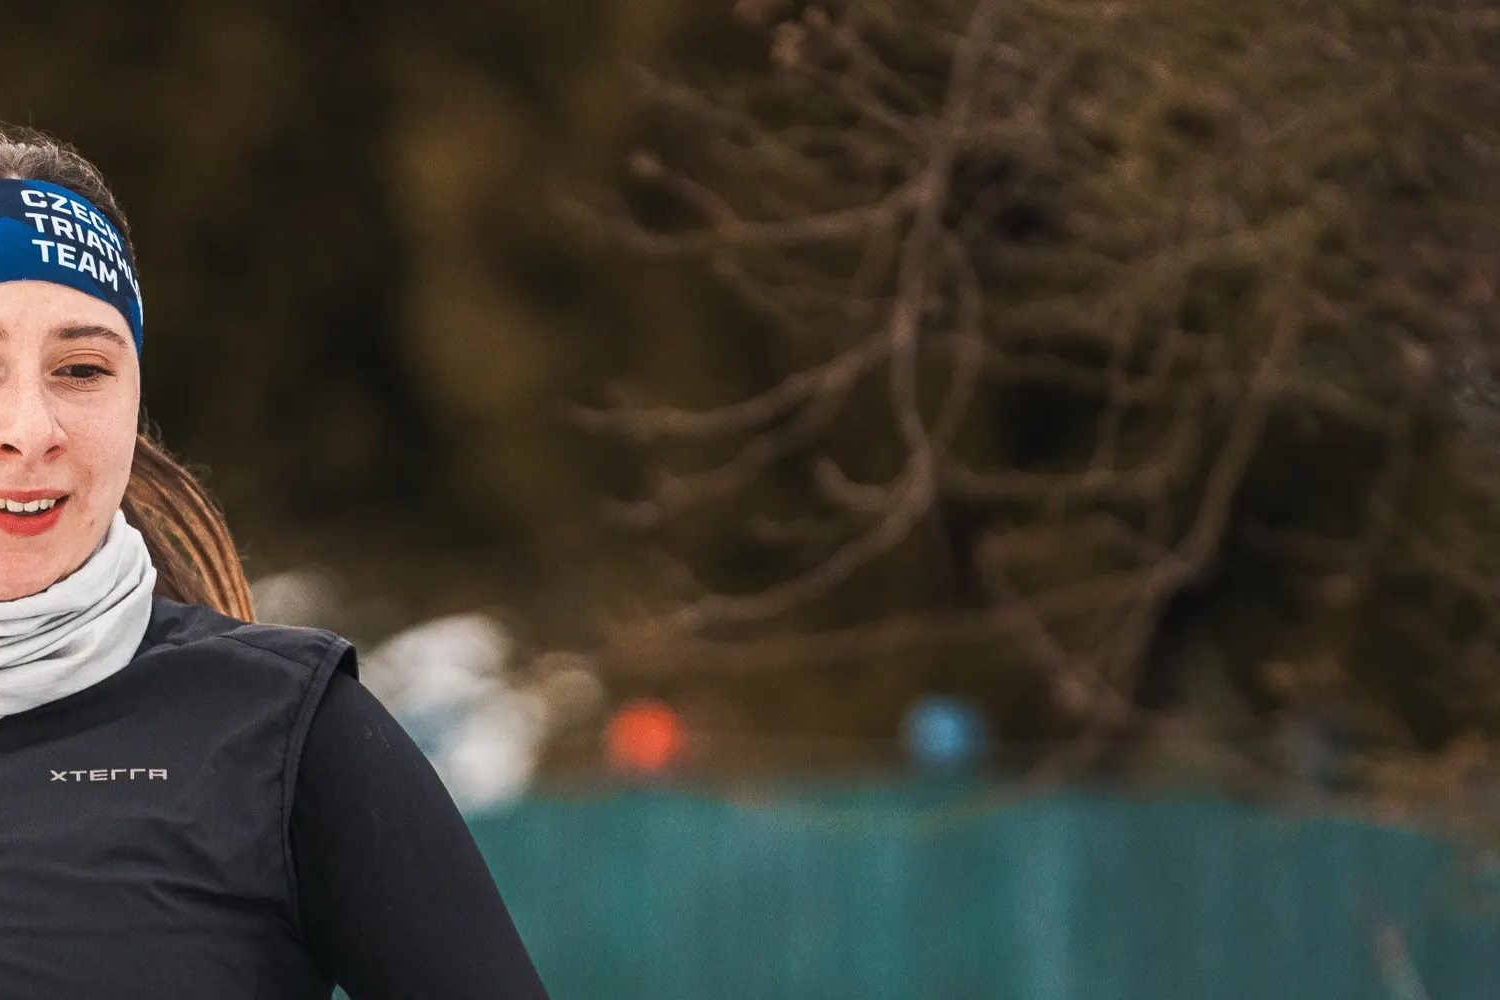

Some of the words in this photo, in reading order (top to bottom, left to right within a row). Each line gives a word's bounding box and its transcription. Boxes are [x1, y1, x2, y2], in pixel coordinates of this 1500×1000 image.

[20, 189, 122, 252] CZECH
[25, 212, 143, 326] TRIATHL
[32, 239, 118, 292] TEAM
[50, 768, 168, 782] XTERRA
